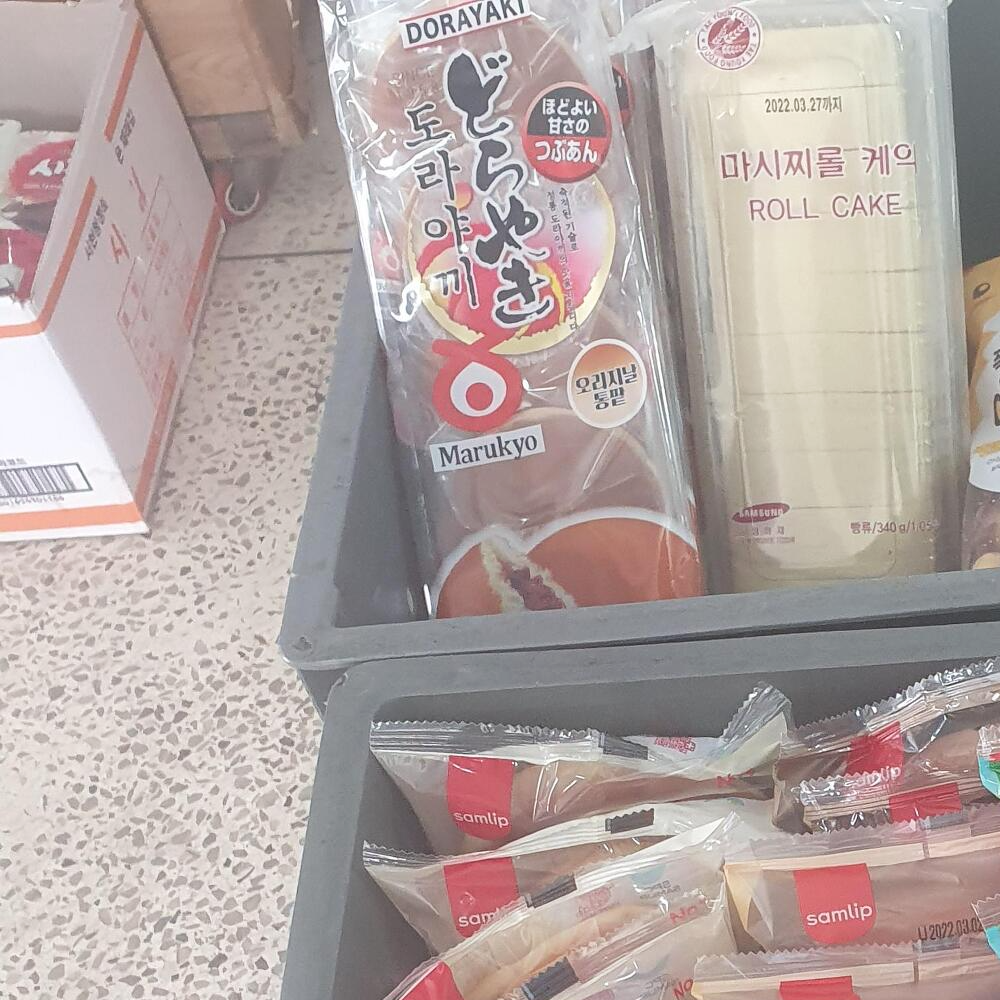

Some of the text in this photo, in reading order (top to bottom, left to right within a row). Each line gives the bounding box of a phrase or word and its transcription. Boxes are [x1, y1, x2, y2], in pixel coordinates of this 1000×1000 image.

[406, 0, 526, 44] DORAYAKI
[542, 98, 597, 116] ほどよい
[765, 96, 842, 113] 2022.03.27까지
[548, 117, 589, 135] 甘さの
[535, 140, 598, 163] つぶあん
[720, 147, 845, 182] 마시찌롤
[446, 51, 552, 326] どらやき
[404, 103, 479, 308] 도라야끼
[750, 193, 902, 221] ROLL CAKE
[575, 364, 637, 394] 오리지날
[594, 387, 626, 410] 통팥
[438, 435, 538, 468] Marukyo
[453, 811, 509, 829] samlip
[458, 910, 502, 927] sam
[806, 903, 873, 926] samlip
